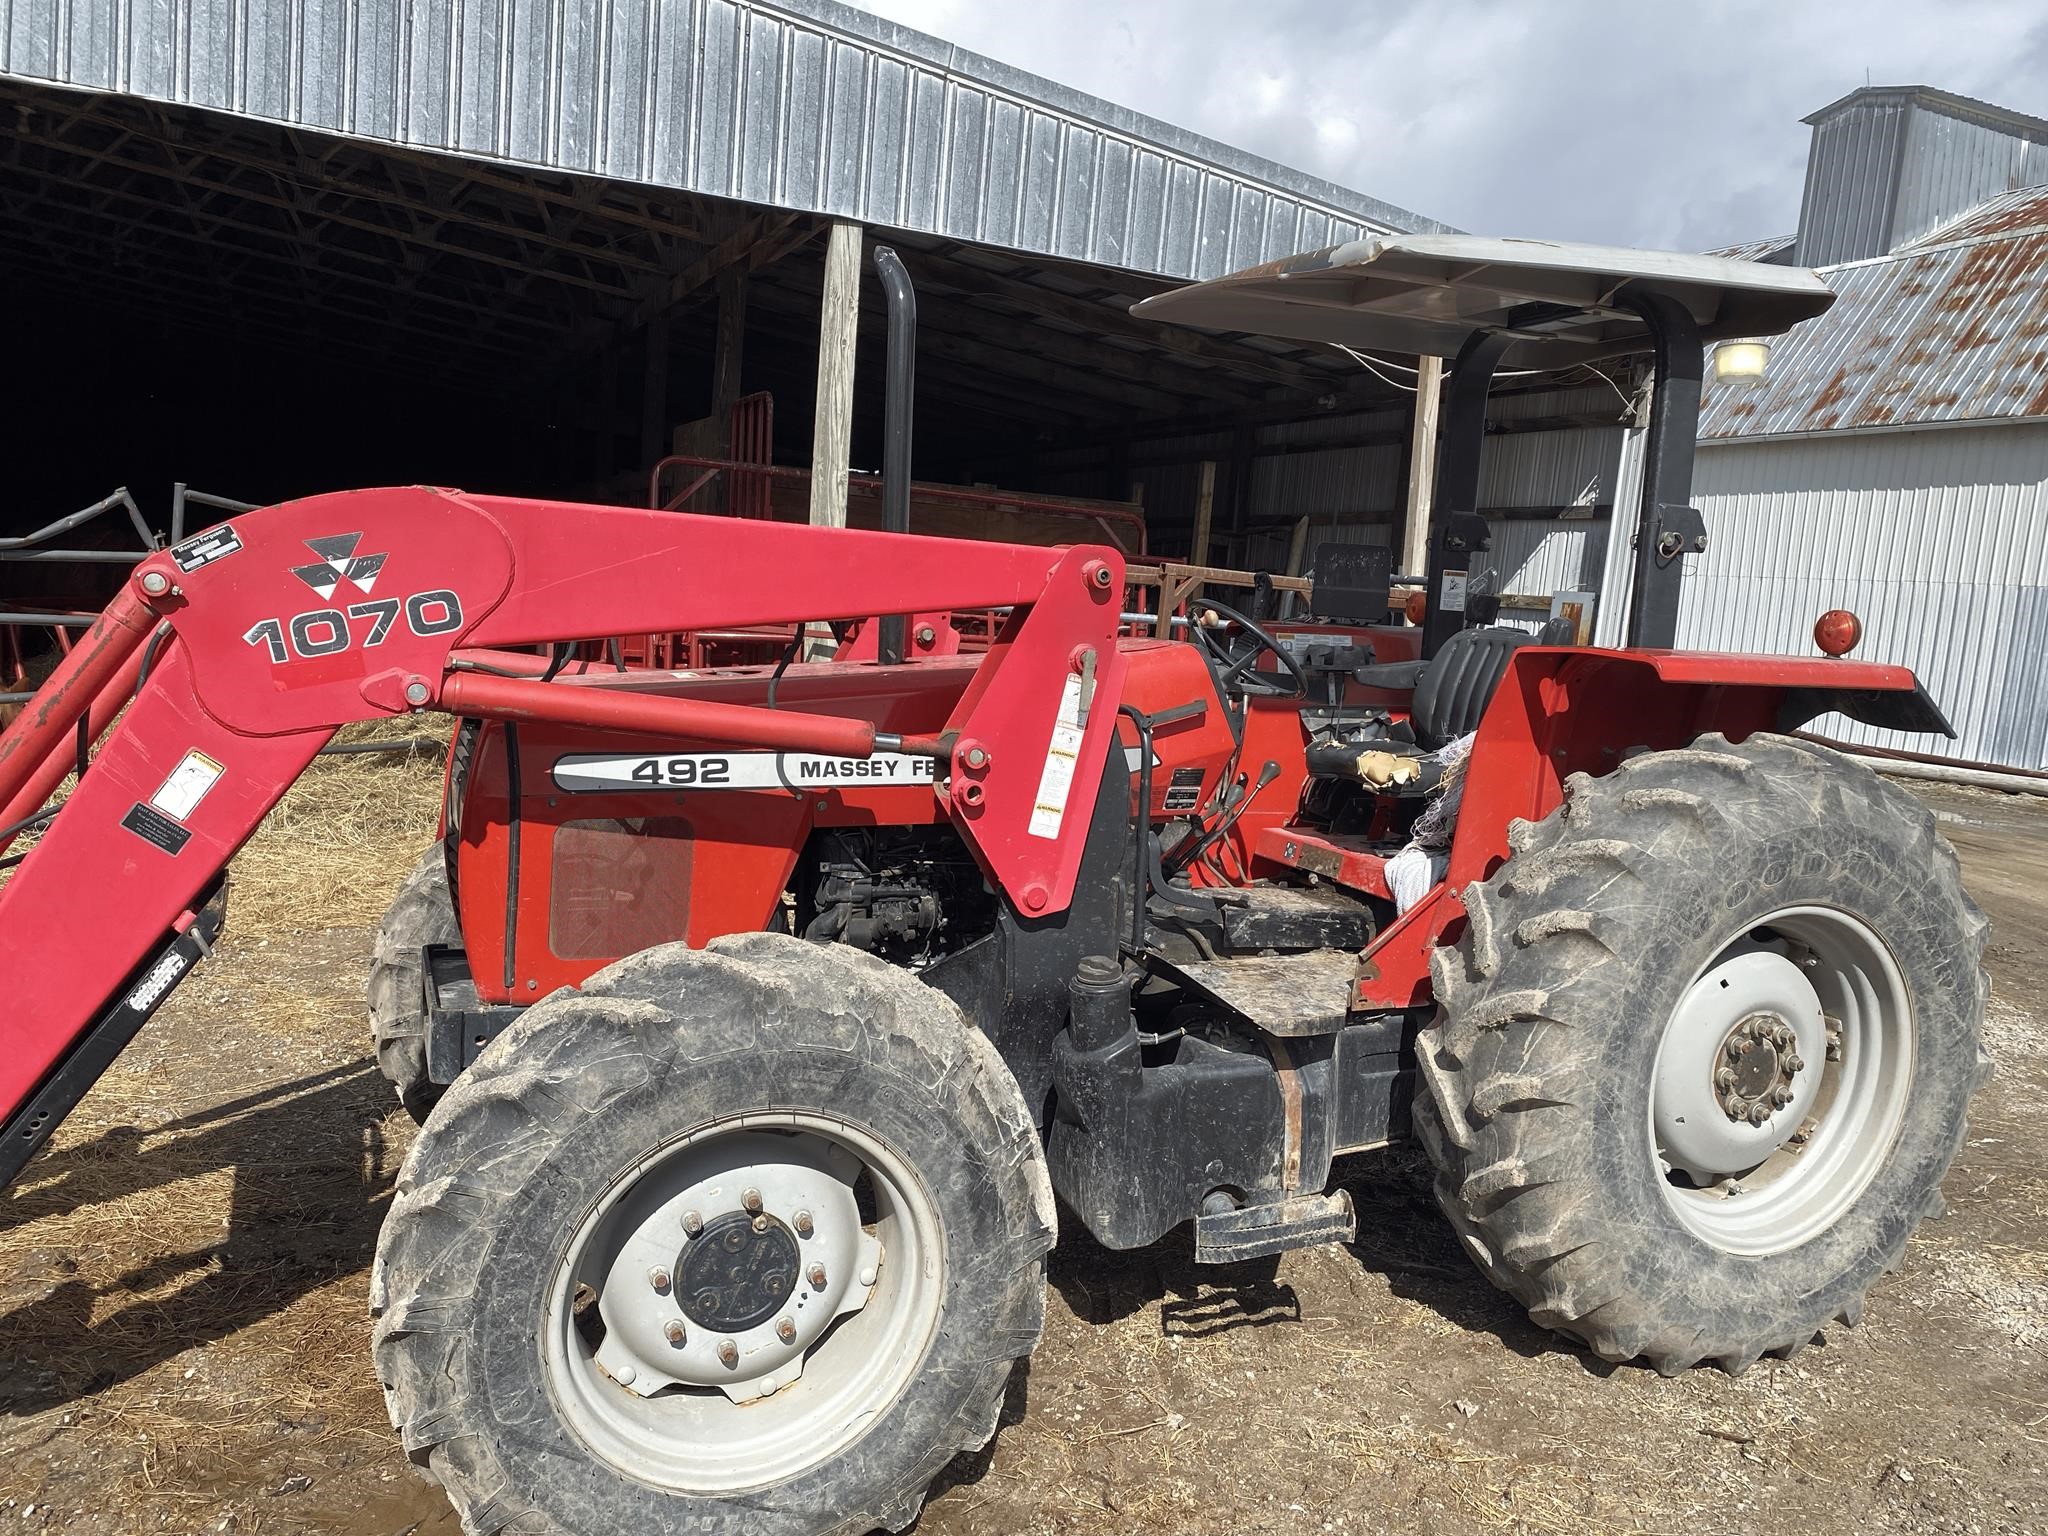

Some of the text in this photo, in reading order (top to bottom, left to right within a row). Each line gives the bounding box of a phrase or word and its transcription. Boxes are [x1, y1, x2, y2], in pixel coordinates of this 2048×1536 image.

[178, 528, 226, 553] Massey Ferguson
[242, 589, 464, 664] 1070
[631, 758, 730, 785] 492
[800, 760, 899, 778] MASSEY
